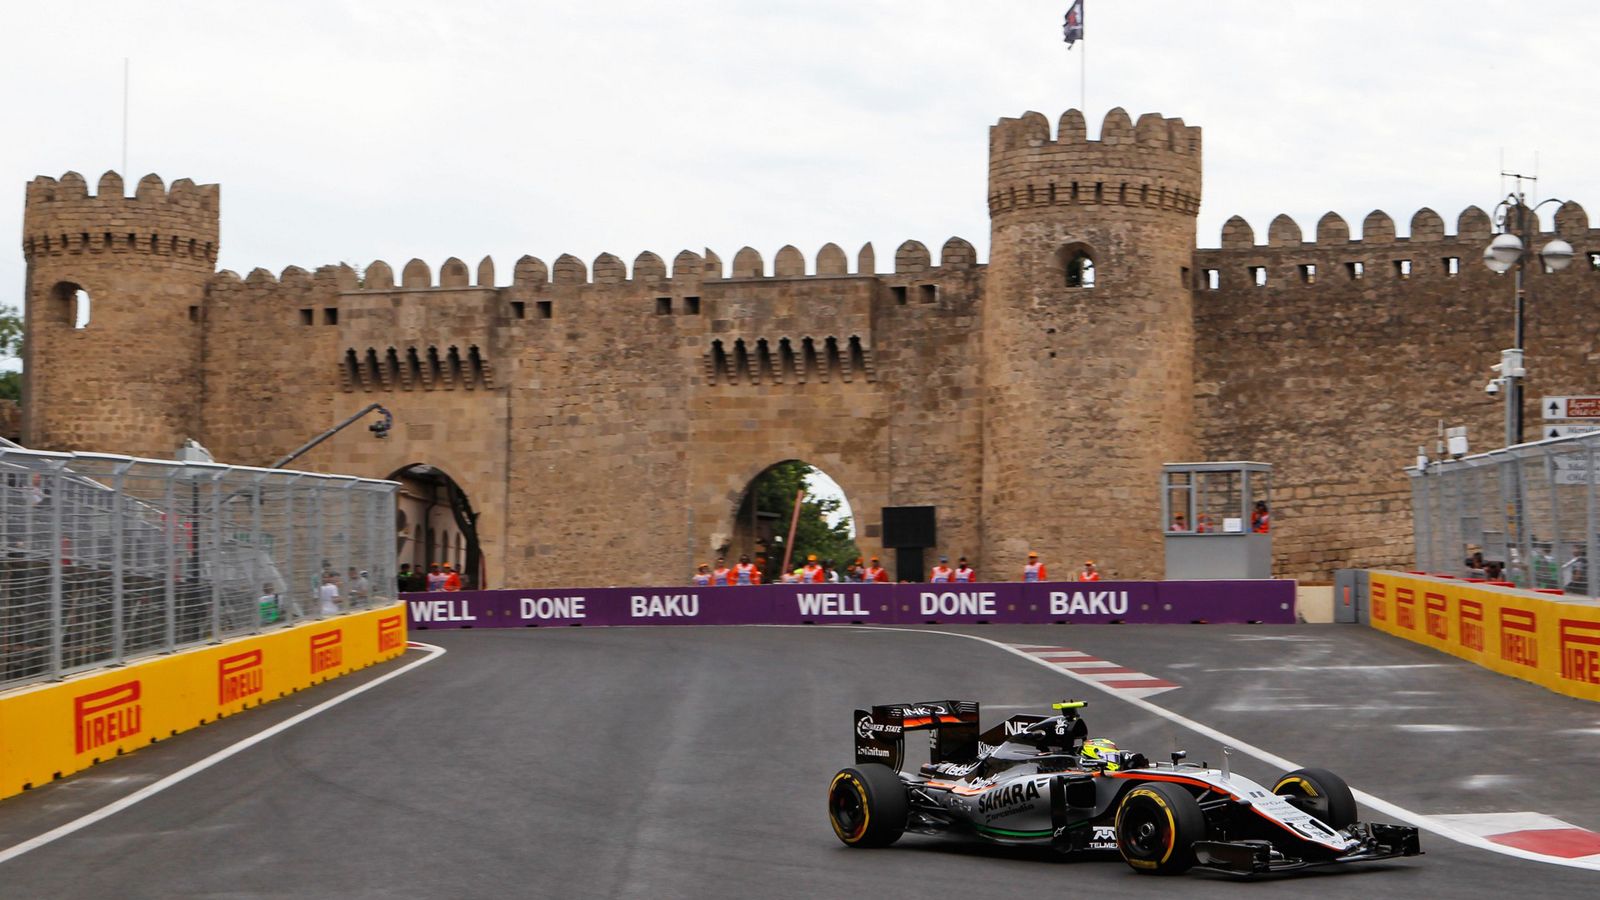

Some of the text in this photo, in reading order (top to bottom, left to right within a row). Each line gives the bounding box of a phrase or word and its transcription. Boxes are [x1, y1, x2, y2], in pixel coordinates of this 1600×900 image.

[411, 594, 699, 622] WELL DONE BAKU
[797, 591, 1128, 616] WELL DONE BAKU
[310, 629, 342, 675] PIRELLI
[377, 614, 402, 653] PIRELLI
[1500, 607, 1538, 669] PIRELLI
[1560, 619, 1600, 685] PIRE
[218, 649, 263, 706] PIRELLI
[74, 680, 141, 754] PIRELLI
[884, 724, 903, 733] STATE
[977, 779, 1041, 814] SAHARA
